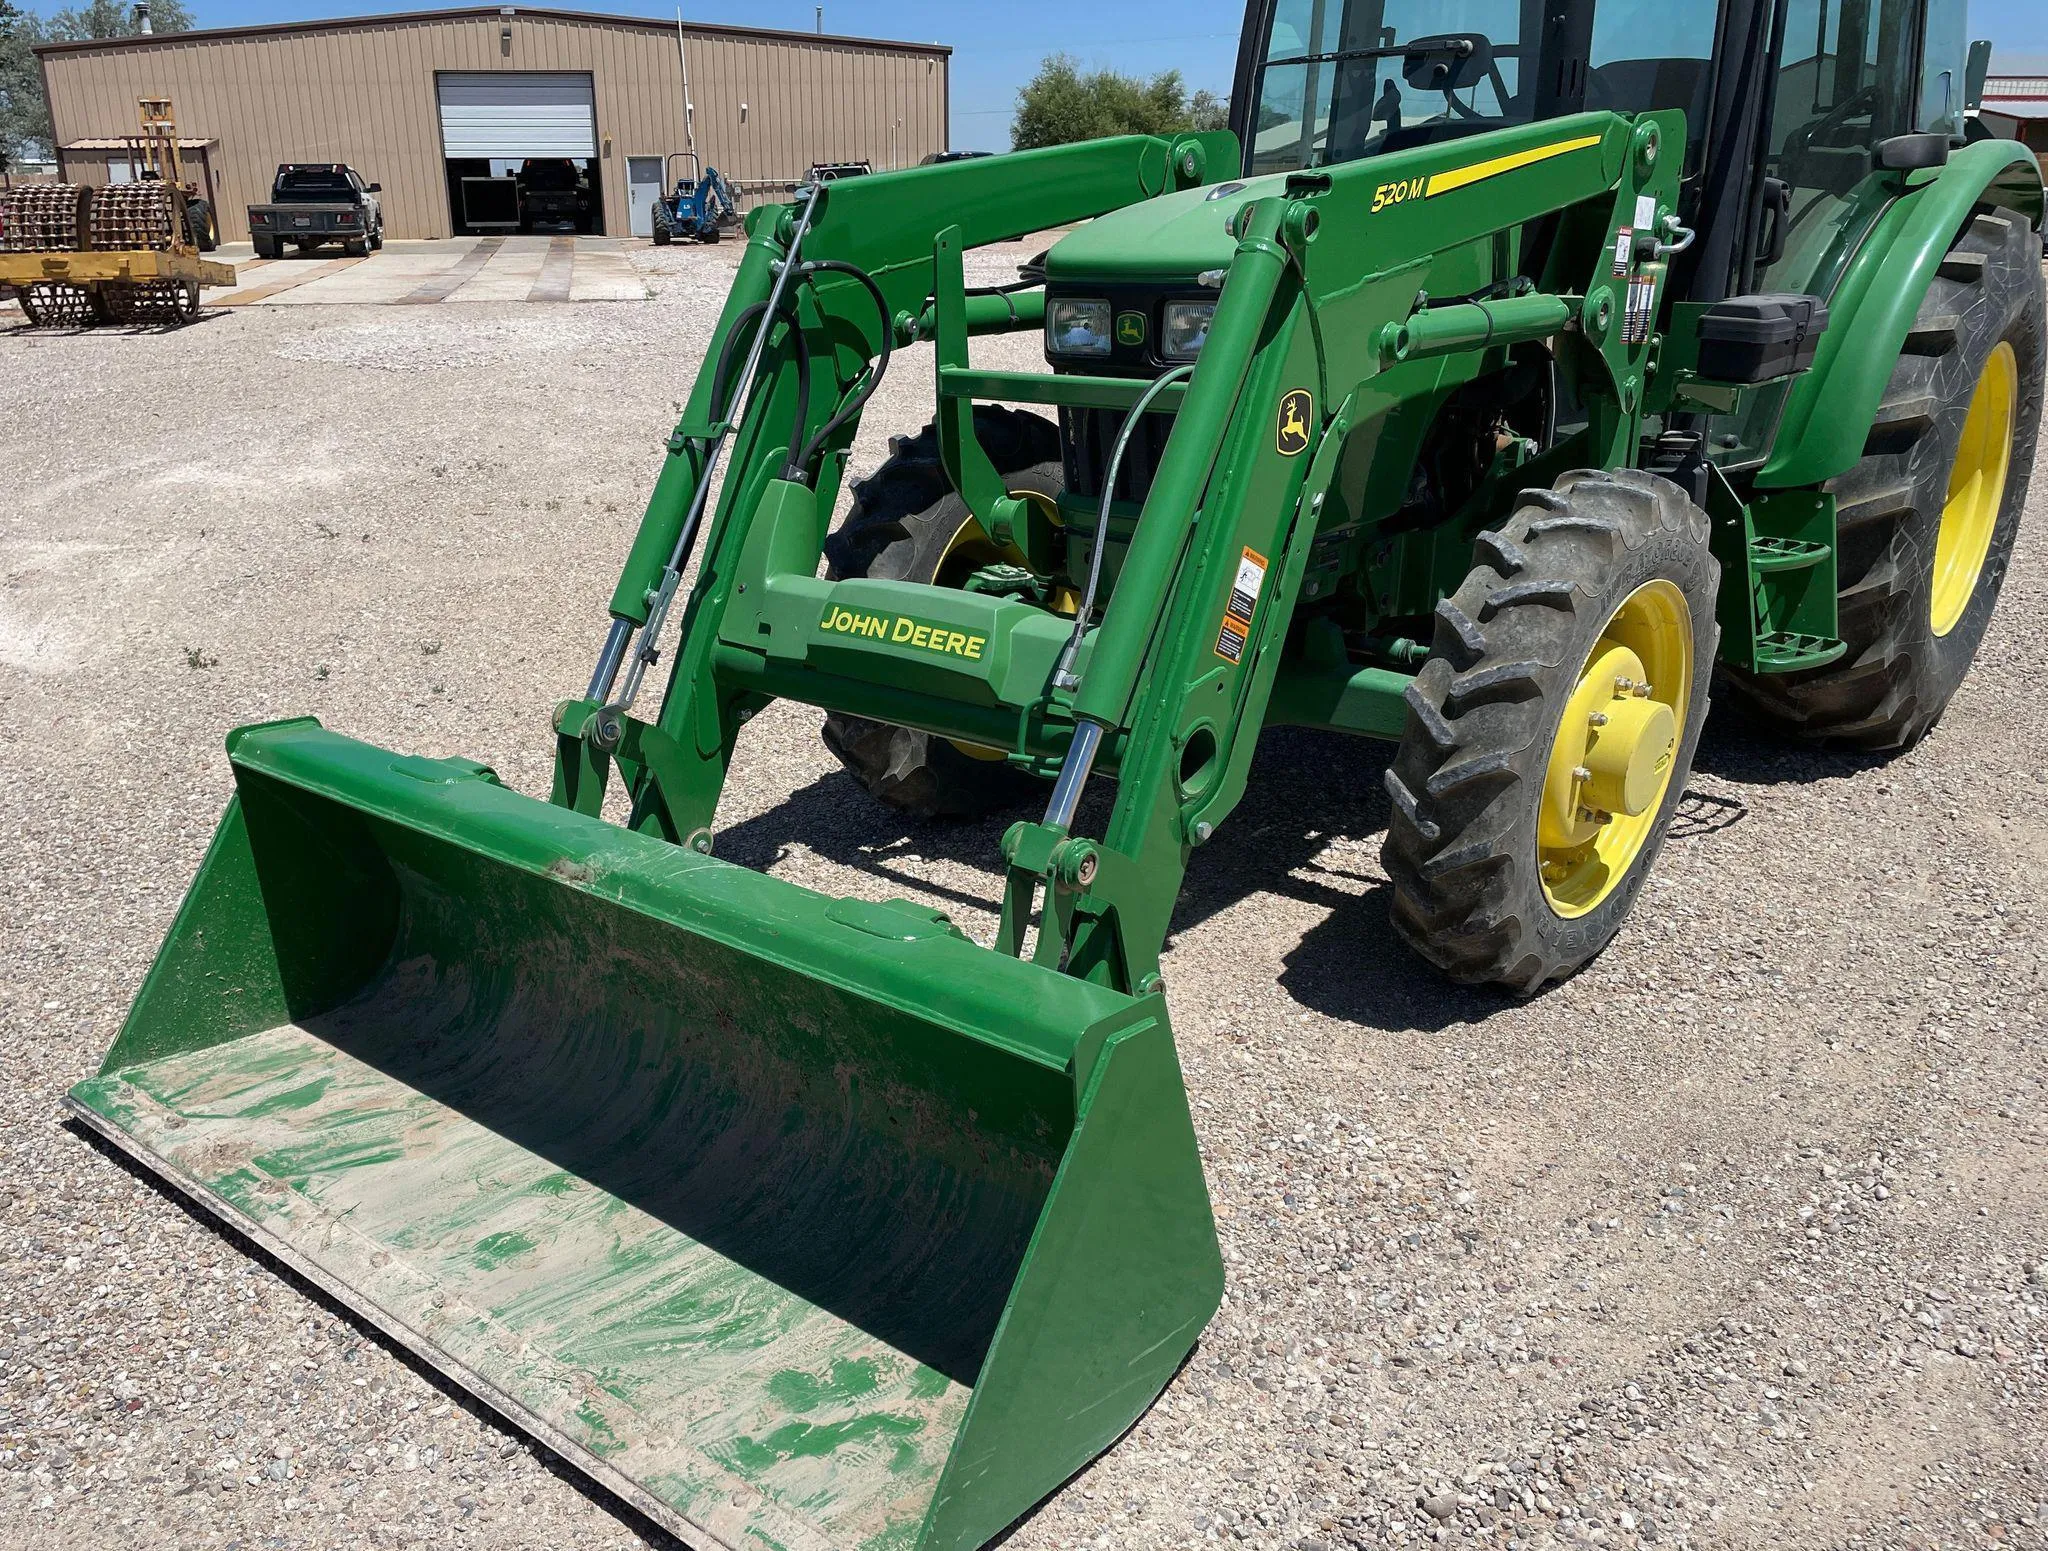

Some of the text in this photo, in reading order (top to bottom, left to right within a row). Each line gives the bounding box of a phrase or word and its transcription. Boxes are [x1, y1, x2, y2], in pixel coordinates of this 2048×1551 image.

[1371, 176, 1425, 213] 520 M
[820, 606, 986, 659] JOHN DEERE
